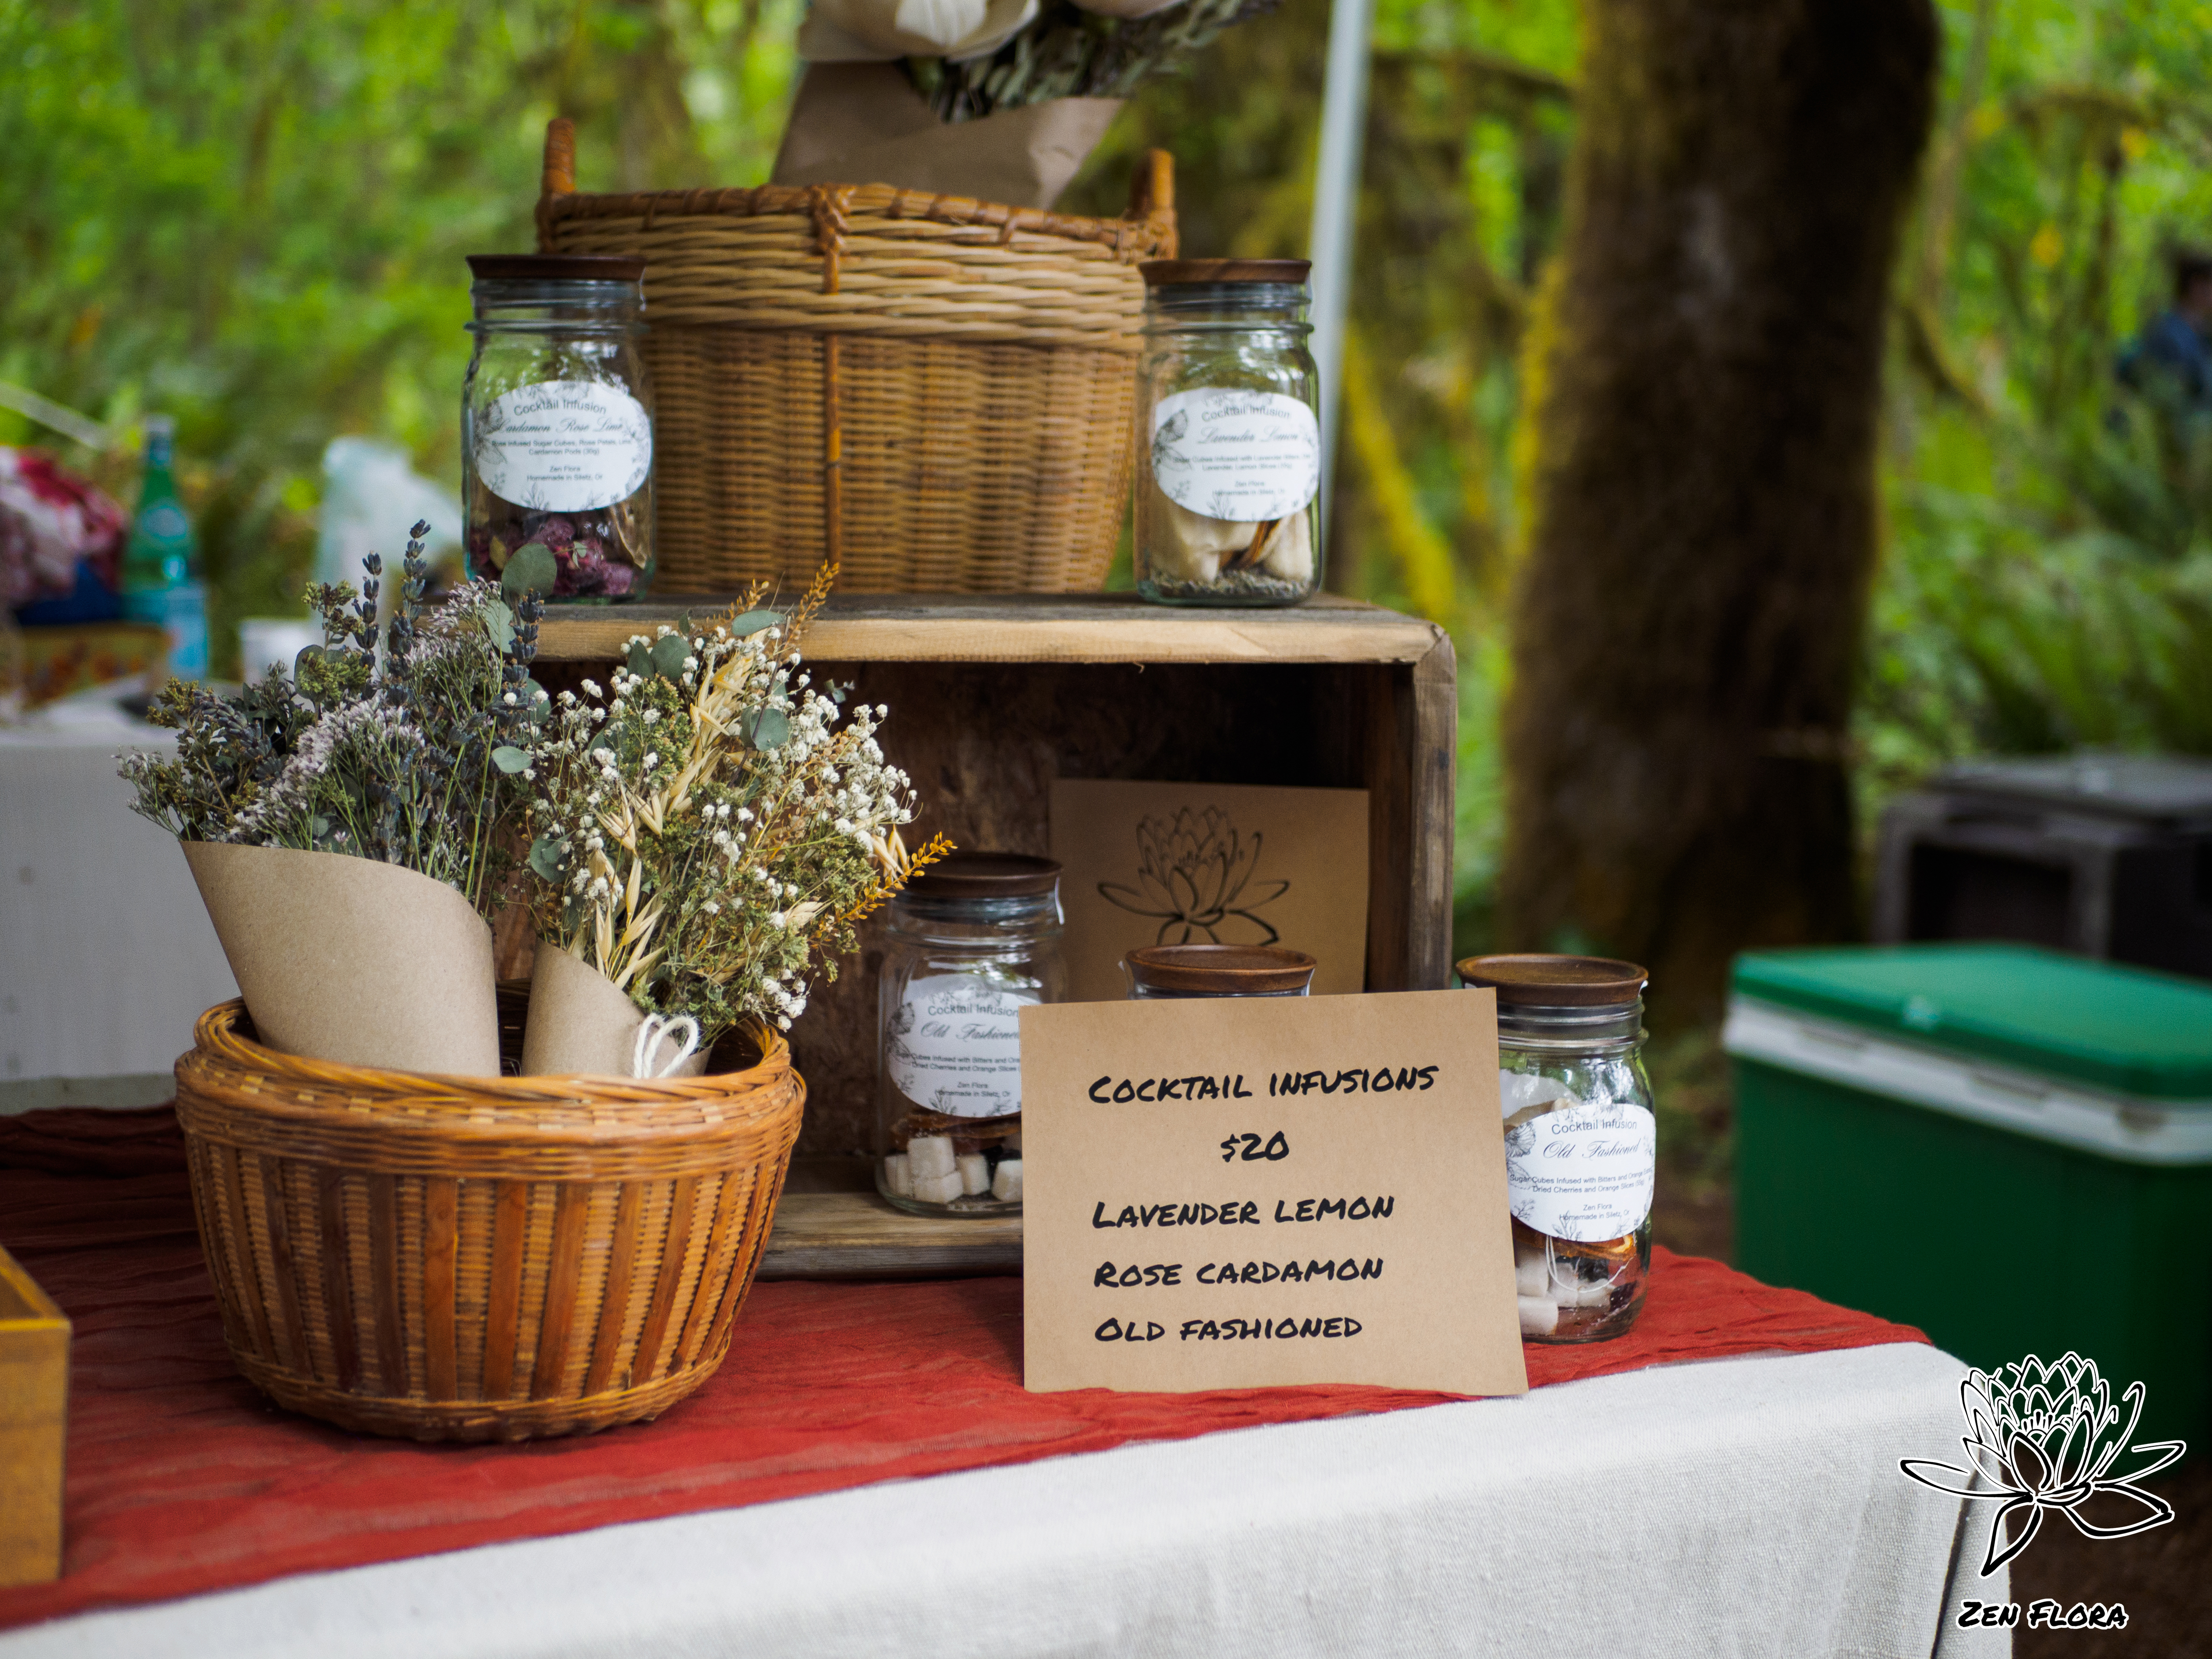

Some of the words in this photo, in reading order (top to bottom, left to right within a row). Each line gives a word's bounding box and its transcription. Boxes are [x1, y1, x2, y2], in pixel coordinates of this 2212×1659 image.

[514, 399, 558, 416] Cocktail
[563, 399, 606, 414] Infusion
[1202, 406, 1246, 422] Cocktail
[1250, 406, 1290, 419] Infusion
[555, 418, 589, 432] Rose
[592, 417, 623, 432] Lime
[1197, 427, 1255, 444] Lavender
[1260, 425, 1298, 442] Lemon
[928, 1003, 973, 1016] Cocktail
[976, 1003, 1019, 1017] Infusion
[920, 1021, 950, 1038] Old
[972, 1065, 997, 1073] Orange
[1088, 1074, 1253, 1104] COCKTAIL
[1269, 1065, 1440, 1097] INFUSIONS
[1551, 1119, 1598, 1135] Cocktail
[1602, 1118, 1637, 1130] Infusion
[1220, 1130, 1290, 1163] $20
[1543, 1141, 1576, 1158] Old
[1582, 1138, 1641, 1161] Fashioned
[1510, 1174, 1531, 1183] Sugar
[1628, 1171, 1643, 1180] Orange
[1621, 1181, 1635, 1190] Slices
[1092, 1201, 1261, 1229] LAVENDER
[1274, 1196, 1395, 1223] LEMON
[1094, 1261, 1183, 1288] ROSE
[1196, 1258, 1383, 1285] CARDAMON
[1094, 1317, 1166, 1342] OLD
[1179, 1317, 1362, 1341] FASHIONED
